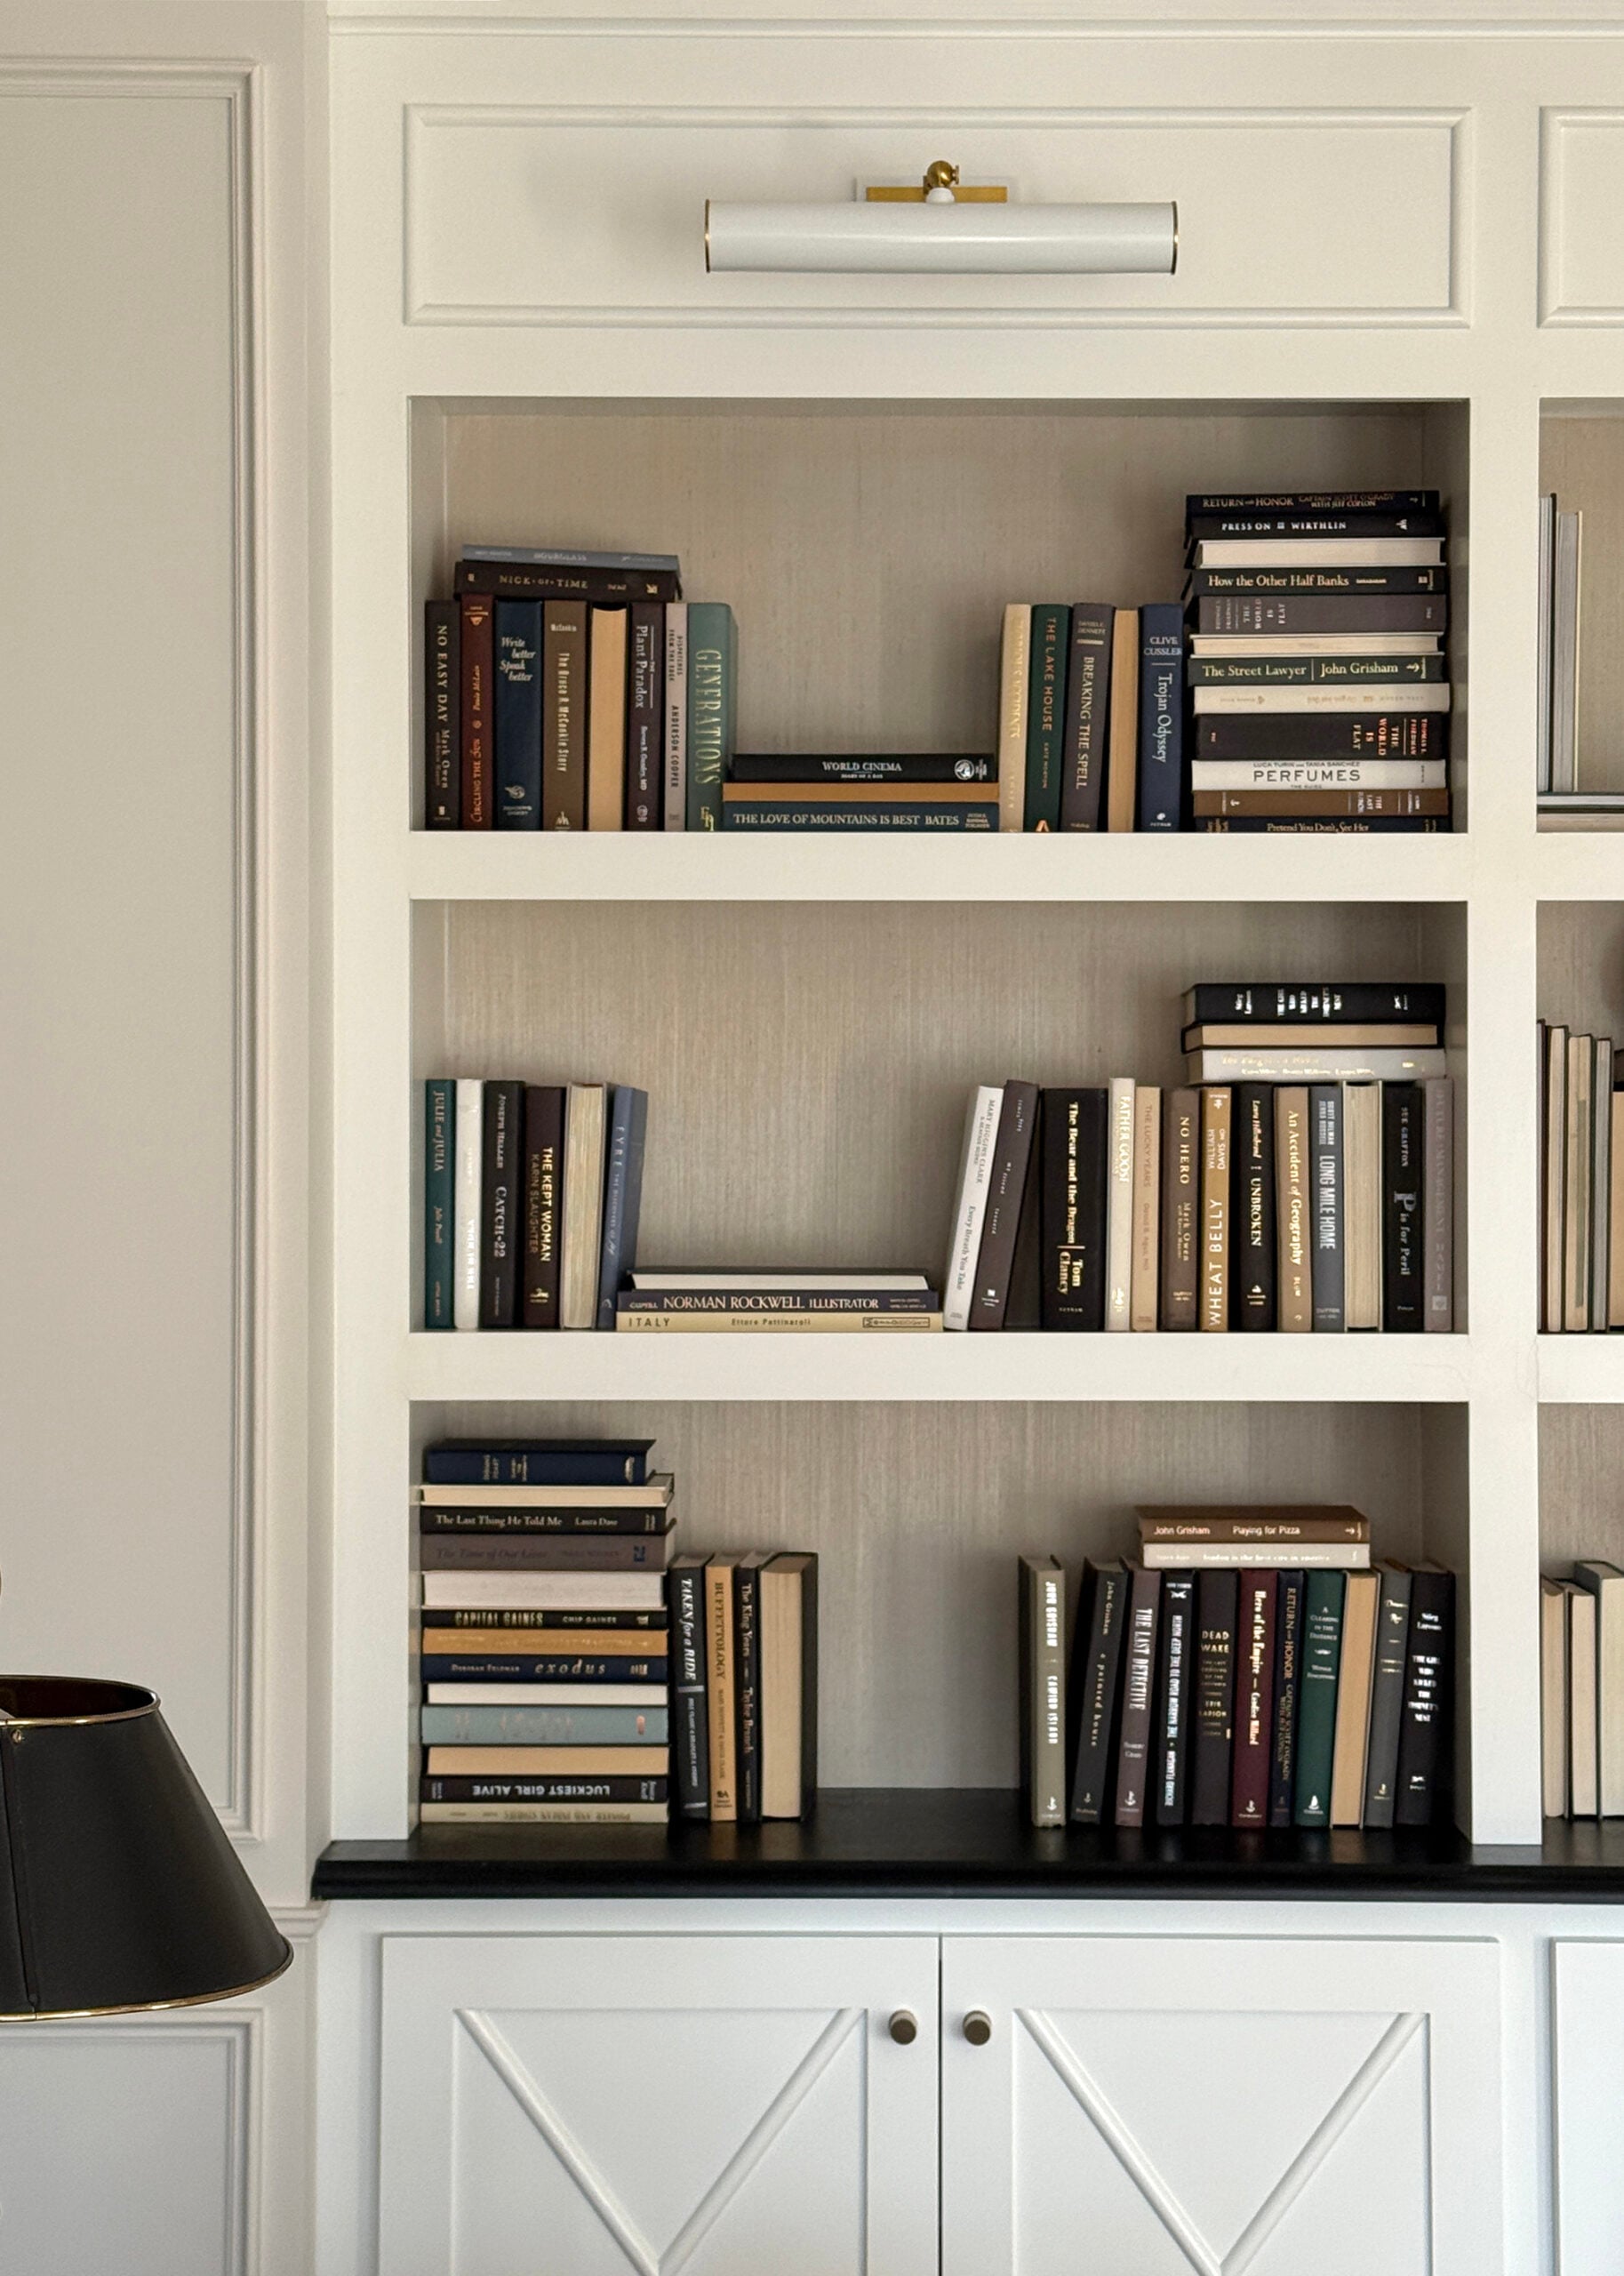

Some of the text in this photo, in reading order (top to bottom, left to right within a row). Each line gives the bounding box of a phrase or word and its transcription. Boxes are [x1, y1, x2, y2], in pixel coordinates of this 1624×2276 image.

[1203, 497, 1294, 508] RETURN HONOR
[1221, 523, 1252, 531] PRESS
[1291, 521, 1347, 531] WIRTHLIN
[1209, 575, 1234, 587] How
[1236, 574, 1254, 586] the
[1256, 574, 1288, 587] Other
[1291, 574, 1316, 586] Half
[1317, 574, 1349, 586] Banks
[437, 625, 448, 645] NO
[500, 637, 525, 648] Write
[1149, 636, 1179, 645] CLIVE
[512, 650, 536, 660] better
[558, 653, 570, 667] The
[1144, 648, 1182, 656] CUSSLER
[437, 653, 448, 688] EASY
[508, 673, 533, 682] better
[635, 625, 648, 708] Plant Paradox
[1042, 617, 1057, 732] THE LAKE HOUSE
[1202, 664, 1307, 678] The Street Lawyer
[1320, 662, 1398, 677] John Grisham
[437, 694, 448, 722] DAY
[695, 649, 723, 785] GENERATIONS
[1152, 673, 1172, 763] Trojan Odyssey
[1076, 656, 1094, 789] BREAKING THE SPELL
[670, 705, 680, 788] ANDERSON COOPER
[1353, 724, 1362, 749] FLAT
[1365, 731, 1374, 742] IS
[1378, 717, 1388, 756] WORLD
[441, 729, 451, 789] Mark Owen
[556, 749, 570, 772] Story
[822, 761, 902, 772] WORLD CINEMA
[1253, 770, 1361, 782] PERFUMES
[733, 813, 758, 824] THE
[760, 813, 791, 825] LOVE
[793, 813, 809, 825] OF
[810, 813, 878, 825] MOUNTAINS
[880, 813, 890, 825] IS
[892, 813, 920, 825] BEST
[925, 814, 960, 825] BATES
[1267, 823, 1297, 832] Pretend
[1299, 823, 1312, 832] You
[433, 1091, 444, 1125] JULIE
[1068, 1102, 1079, 1126] The
[1118, 1095, 1131, 1142] FATHER
[1288, 1110, 1300, 1128] An
[433, 1136, 444, 1172] JULIA
[1068, 1127, 1078, 1157] Bear
[1180, 1117, 1190, 1184] NO HERO
[1288, 1130, 1301, 1184] Accident
[1068, 1158, 1078, 1182] and
[540, 1147, 553, 1262] THE KEPT WOMAN
[1068, 1184, 1077, 1205] the
[1319, 1155, 1336, 1250] LONG MILE HOME
[1251, 1178, 1262, 1246] UNBROKEN
[1182, 1202, 1191, 1262] Mark Owen
[1290, 1198, 1302, 1265] Geography
[1400, 1225, 1411, 1245] for
[956, 1206, 976, 1291] Every Breath You Take
[1057, 1251, 1071, 1294] Clancy
[1072, 1258, 1084, 1287] Tom
[1209, 1199, 1223, 1326] WHEAT BELLY
[1400, 1247, 1412, 1276] Peril
[663, 1295, 726, 1310] NORMAN
[731, 1295, 804, 1310] ROCKWELL
[809, 1297, 879, 1310] ILLUSTRATOR
[628, 1318, 670, 1327] ITALY
[436, 1515, 563, 1528] The Last Thing He Told Me
[1154, 1526, 1211, 1535] John Grisham
[1233, 1526, 1300, 1537] Playing for Pizza
[742, 1583, 752, 1602] The
[455, 1612, 544, 1626] CAPITAL GAINES
[1285, 1587, 1297, 1629] RETURN
[679, 1578, 696, 1680] TAKEN for a RIDE
[715, 1583, 725, 1679] BUFFETTOLOGY
[1202, 1631, 1229, 1640] DEAD
[1250, 1591, 1267, 1674] Hero of the Empire
[1129, 1607, 1153, 1711] THE LAST DETECTIVE
[1201, 1644, 1229, 1654] WAKE
[1284, 1640, 1295, 1679] HONOR
[534, 1659, 606, 1675] exodus
[472, 1784, 610, 1796] LUCKIEST GIRL ALIVE
